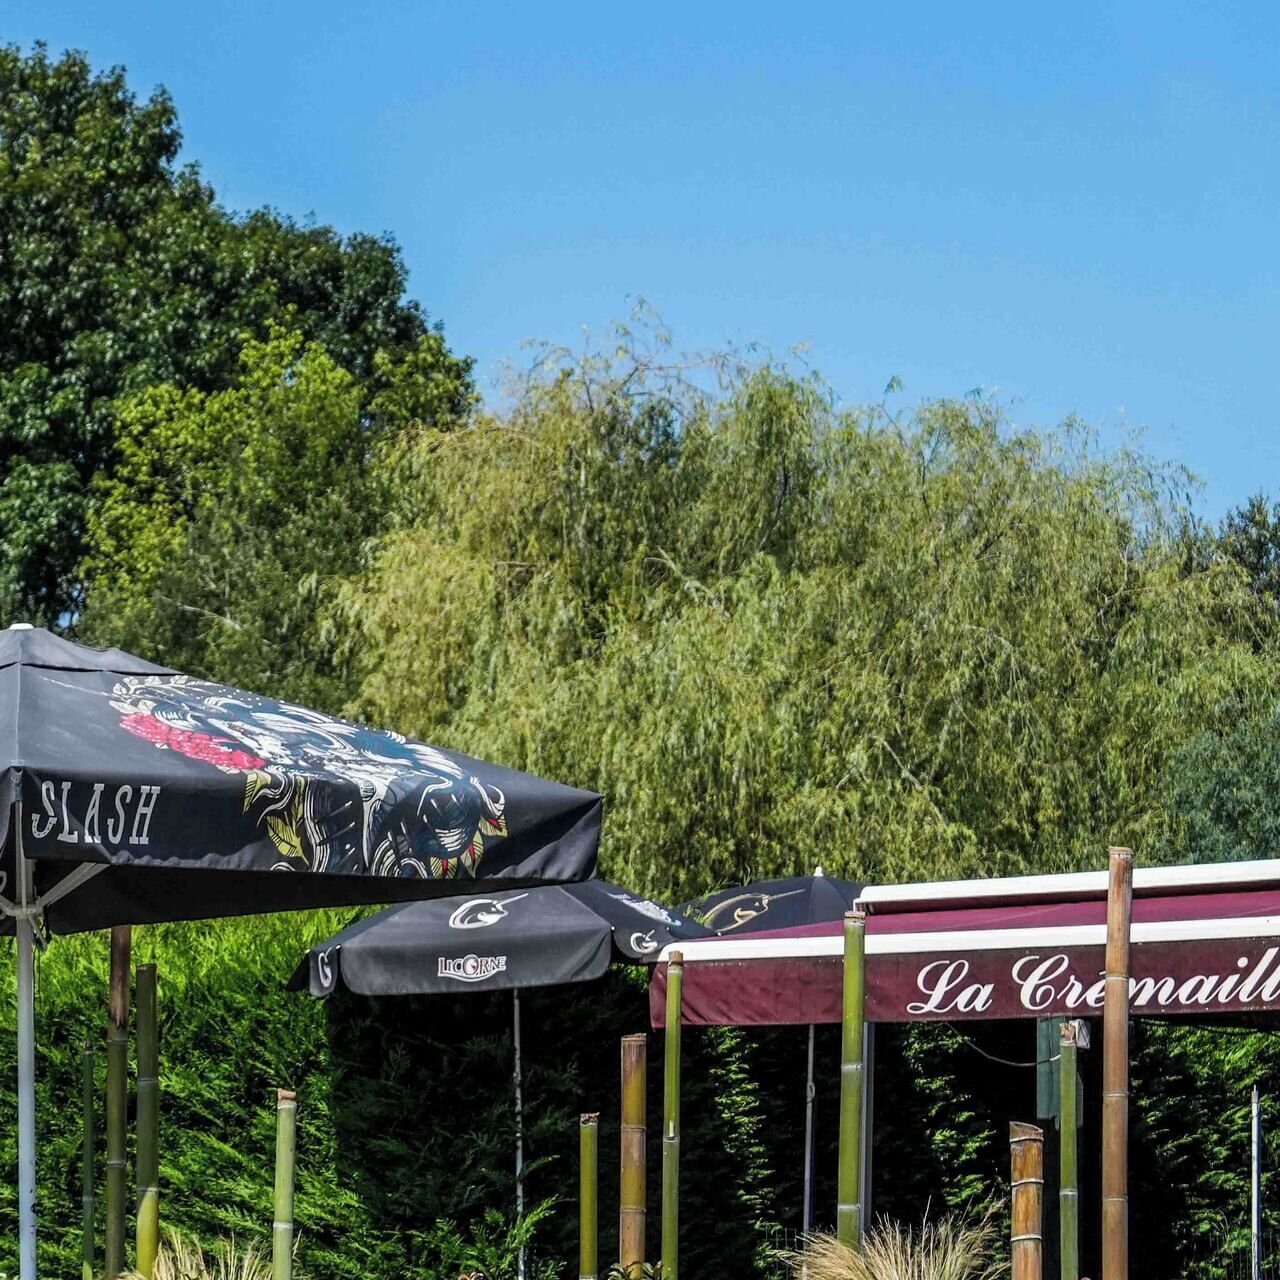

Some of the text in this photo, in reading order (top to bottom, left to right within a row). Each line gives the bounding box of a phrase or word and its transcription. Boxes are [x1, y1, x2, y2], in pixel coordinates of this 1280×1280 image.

[31, 780, 161, 845] SLASH
[437, 954, 508, 980] LICORNE
[906, 959, 995, 1014] La
